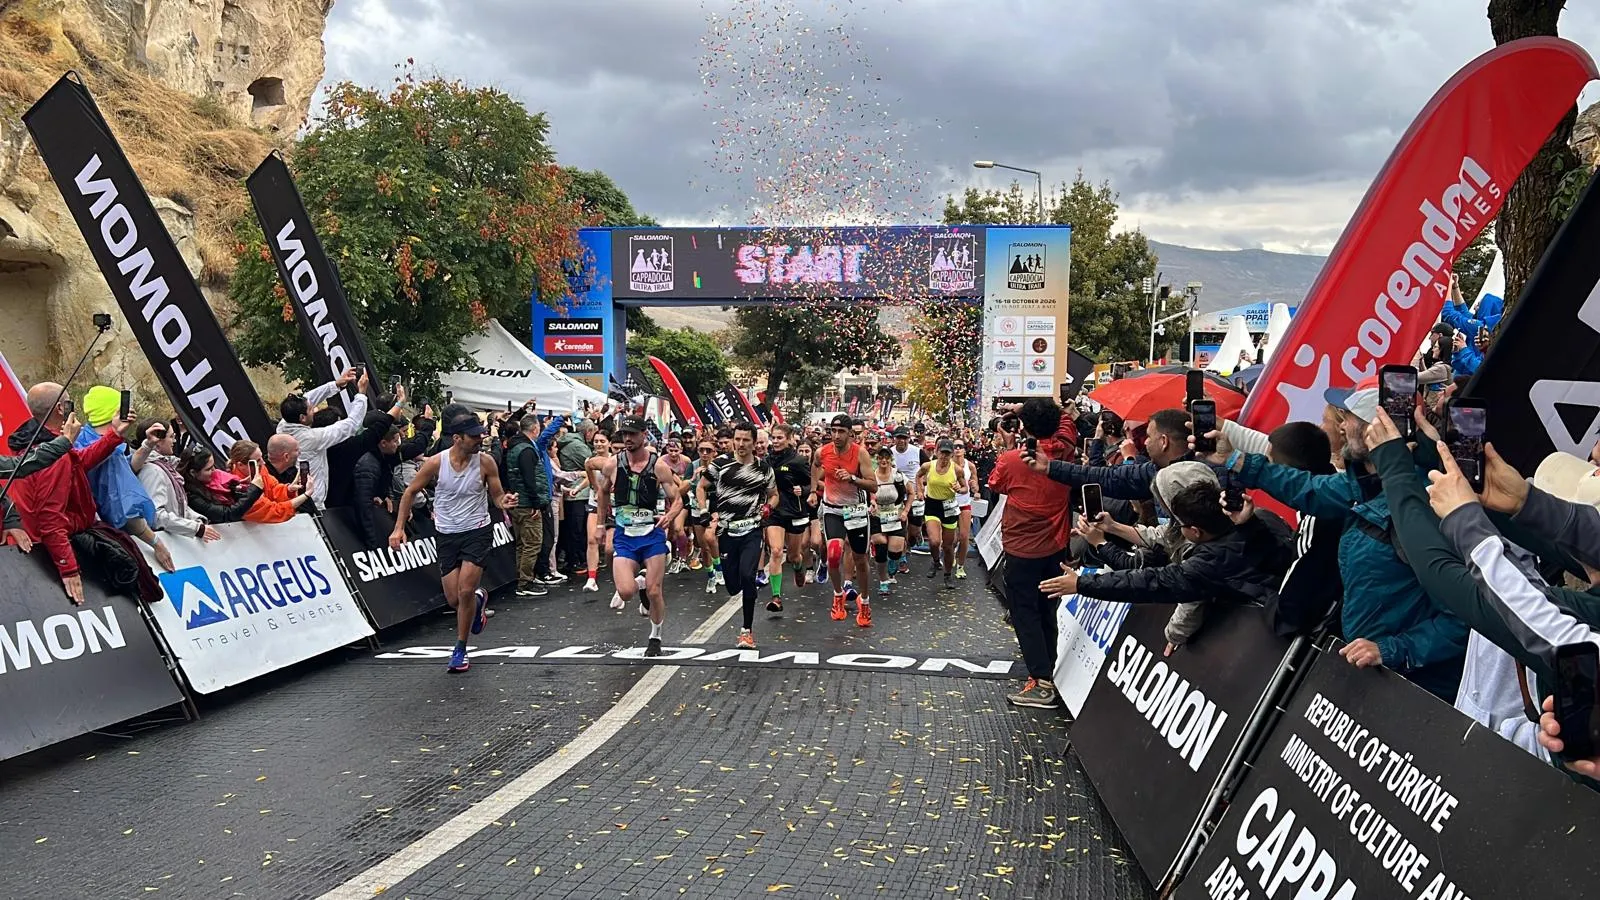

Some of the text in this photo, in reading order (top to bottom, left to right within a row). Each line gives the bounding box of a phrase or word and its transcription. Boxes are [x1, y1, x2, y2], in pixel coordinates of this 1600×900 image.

[632, 272, 672, 282] CAPPADOCIA
[736, 244, 870, 284] START
[931, 270, 971, 282] CAPPADOCIA
[1010, 273, 1043, 282] CAPPADOCIA
[1341, 156, 1491, 384] corendon
[633, 283, 652, 291] ULTRA
[219, 555, 332, 619] ARGEUS
[192, 600, 344, 650] Travel & Events
[375, 645, 1014, 674] SALOMON
[1107, 635, 1228, 771] SALOMON
[1304, 692, 1459, 833] REPUBLIC OF TÜRKİYE
[1280, 734, 1342, 802] MINISTRY
[1331, 783, 1360, 820] OF
[1350, 803, 1430, 893] CULTURE
